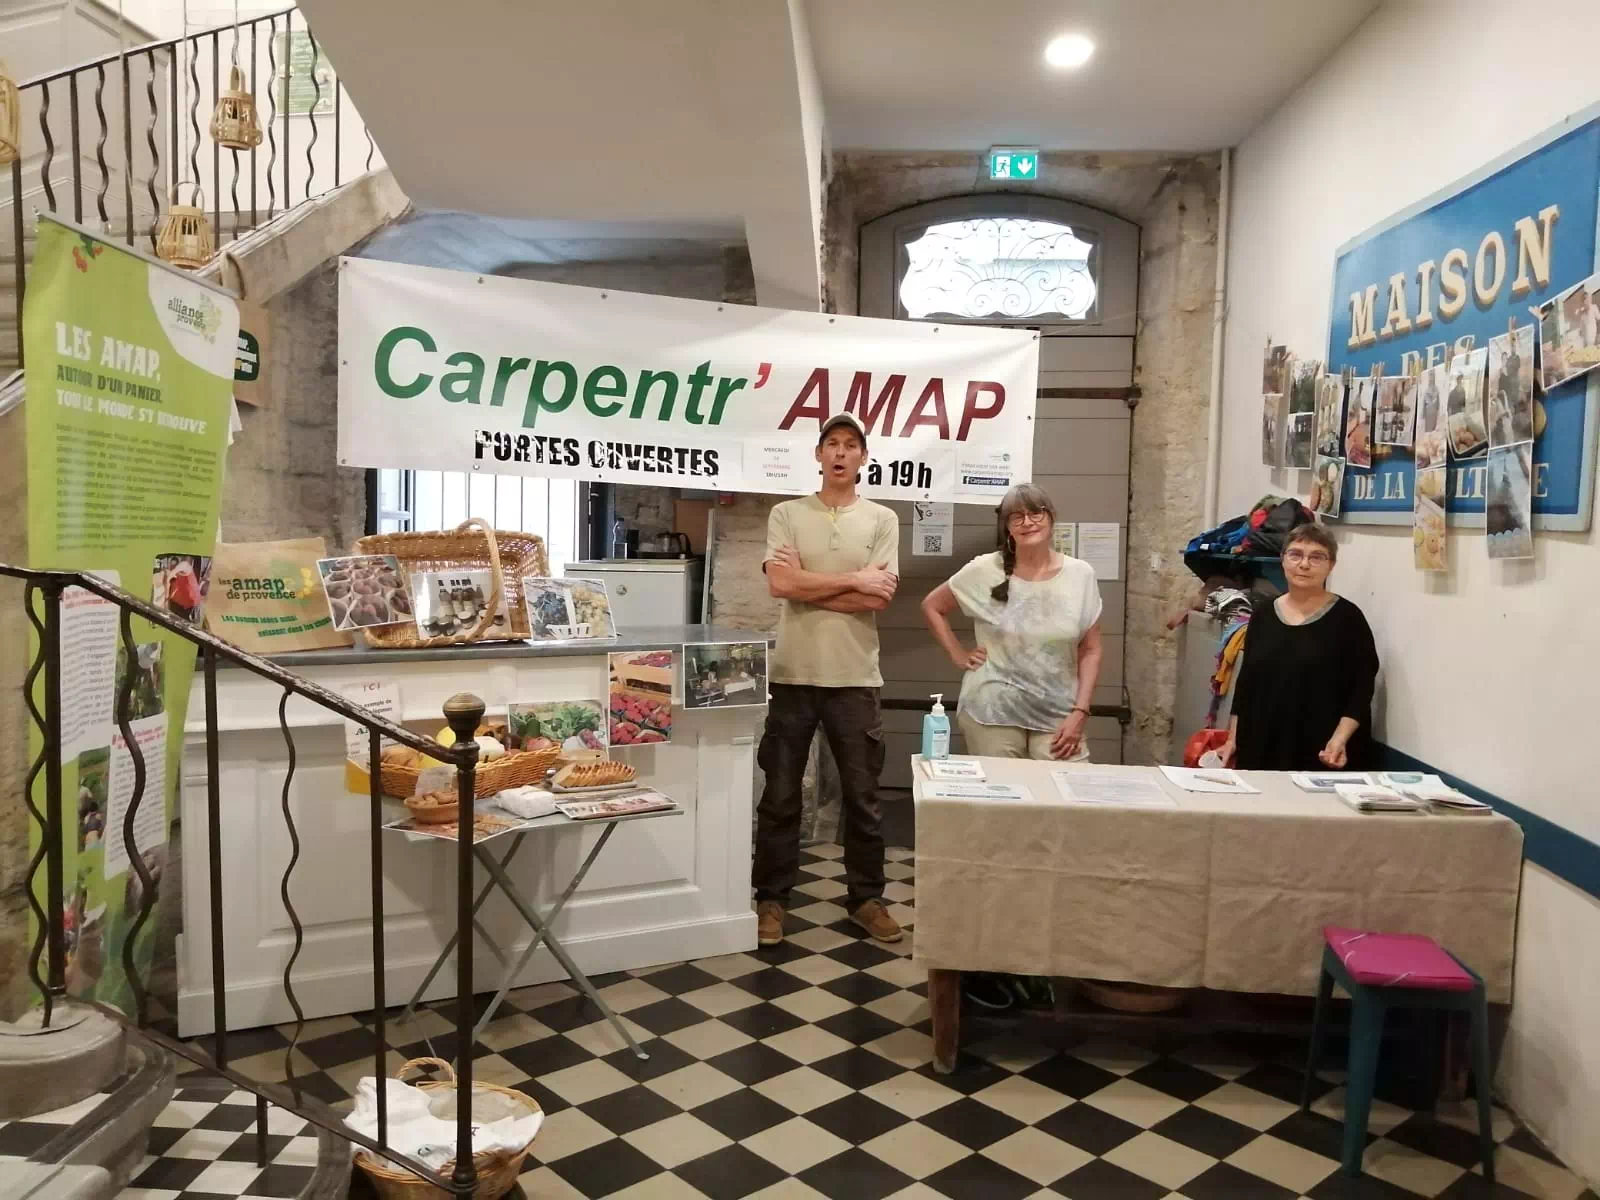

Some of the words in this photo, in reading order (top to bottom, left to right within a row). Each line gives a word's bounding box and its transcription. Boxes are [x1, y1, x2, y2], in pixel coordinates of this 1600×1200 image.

[1348, 204, 1560, 347] MAISON
[56, 321, 92, 361] LES
[778, 367, 1006, 442] AMAP
[474, 429, 580, 467] PORTES
[588, 440, 719, 477] OUVERTES
[868, 459, 882, 486] à
[1354, 474, 1377, 500] DE
[1383, 471, 1406, 499] LA
[226, 589, 241, 600] de
[242, 591, 296, 602] provence
[232, 578, 285, 597] amap
